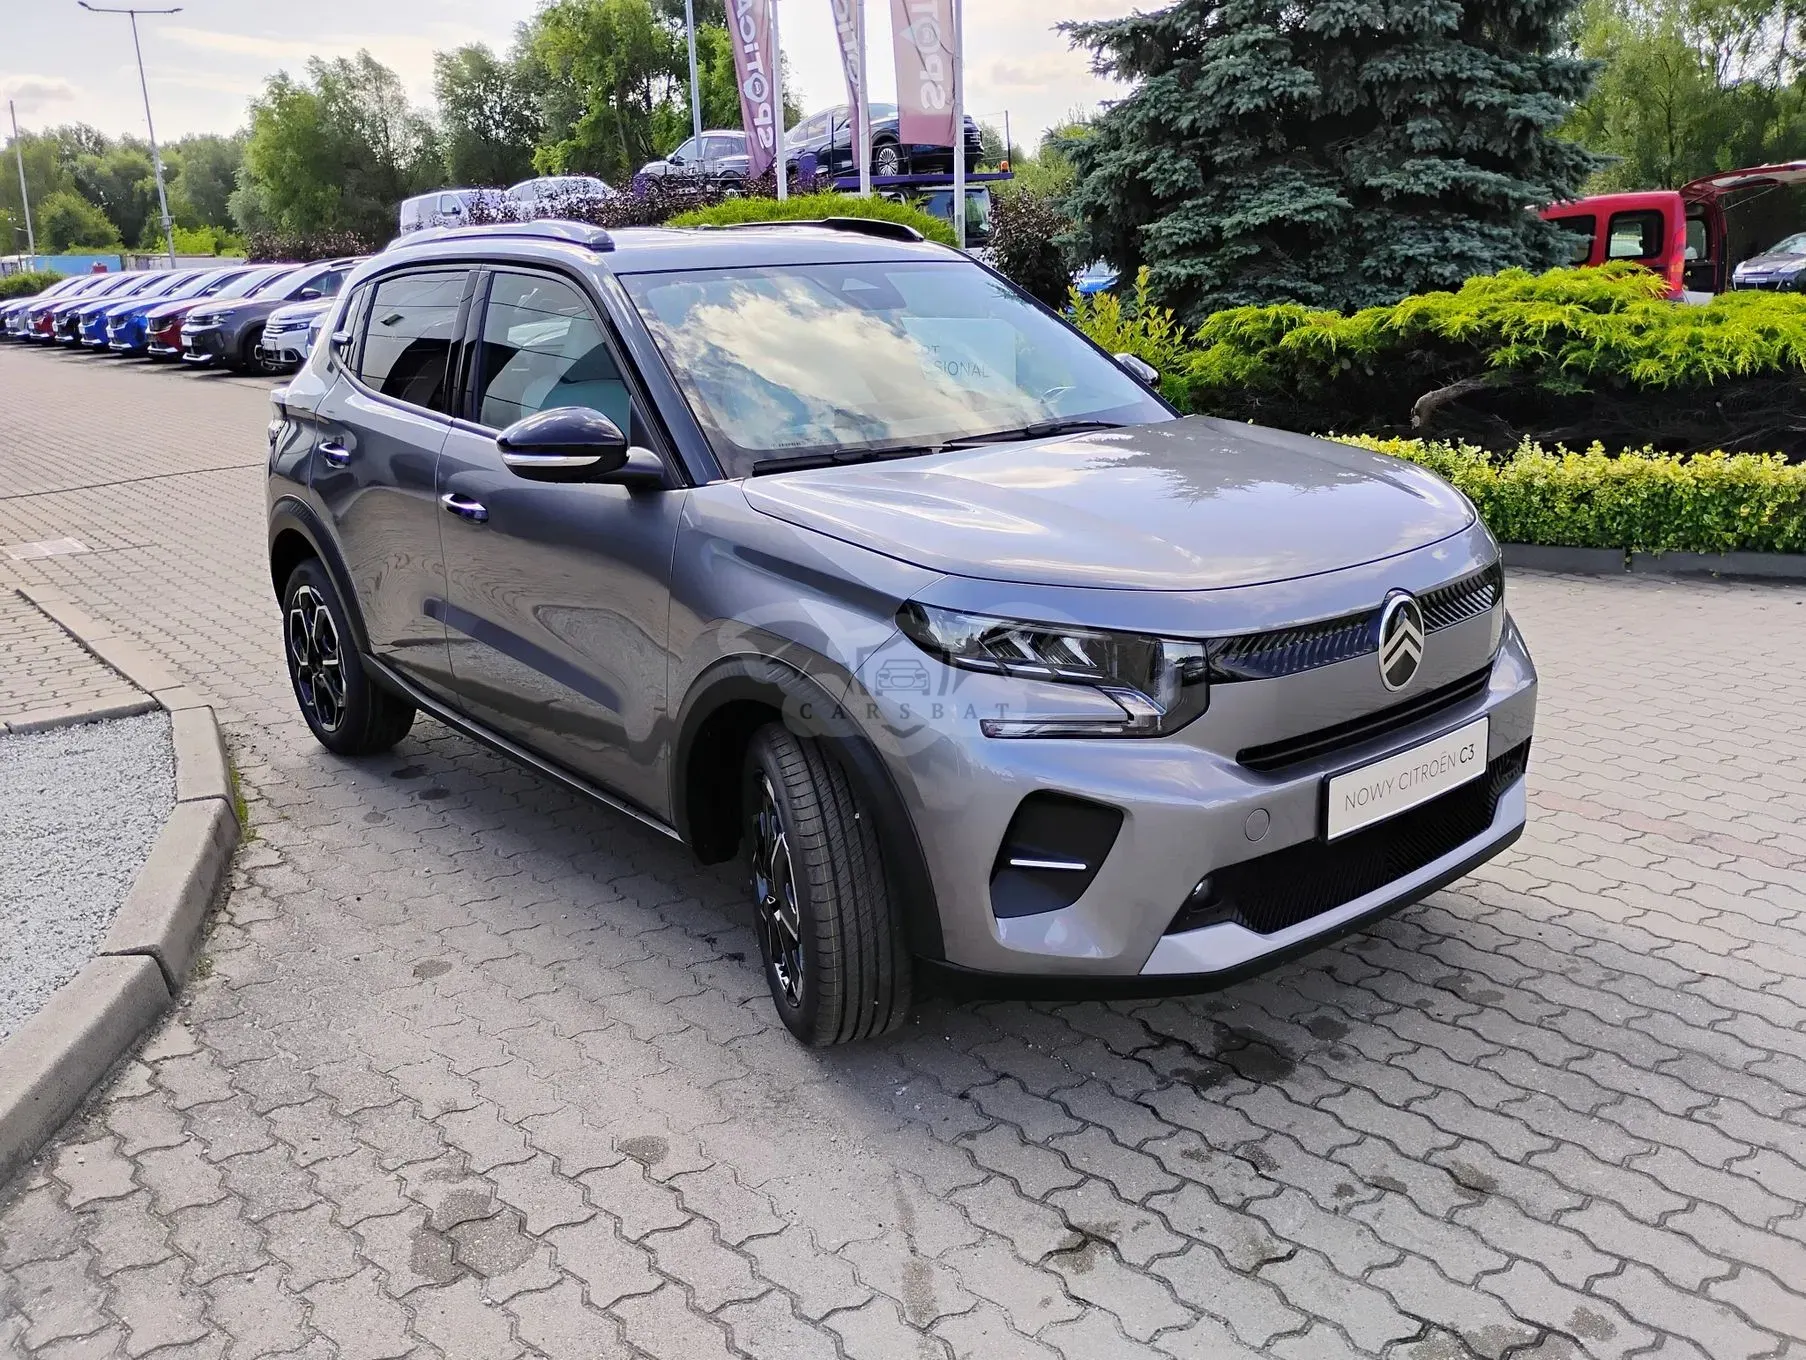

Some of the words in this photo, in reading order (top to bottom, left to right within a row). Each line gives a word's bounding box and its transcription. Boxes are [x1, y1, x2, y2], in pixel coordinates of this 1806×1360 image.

[1344, 778, 1395, 812] NOWY
[1399, 751, 1456, 790] CITROËN
[1459, 743, 1475, 764] C3
